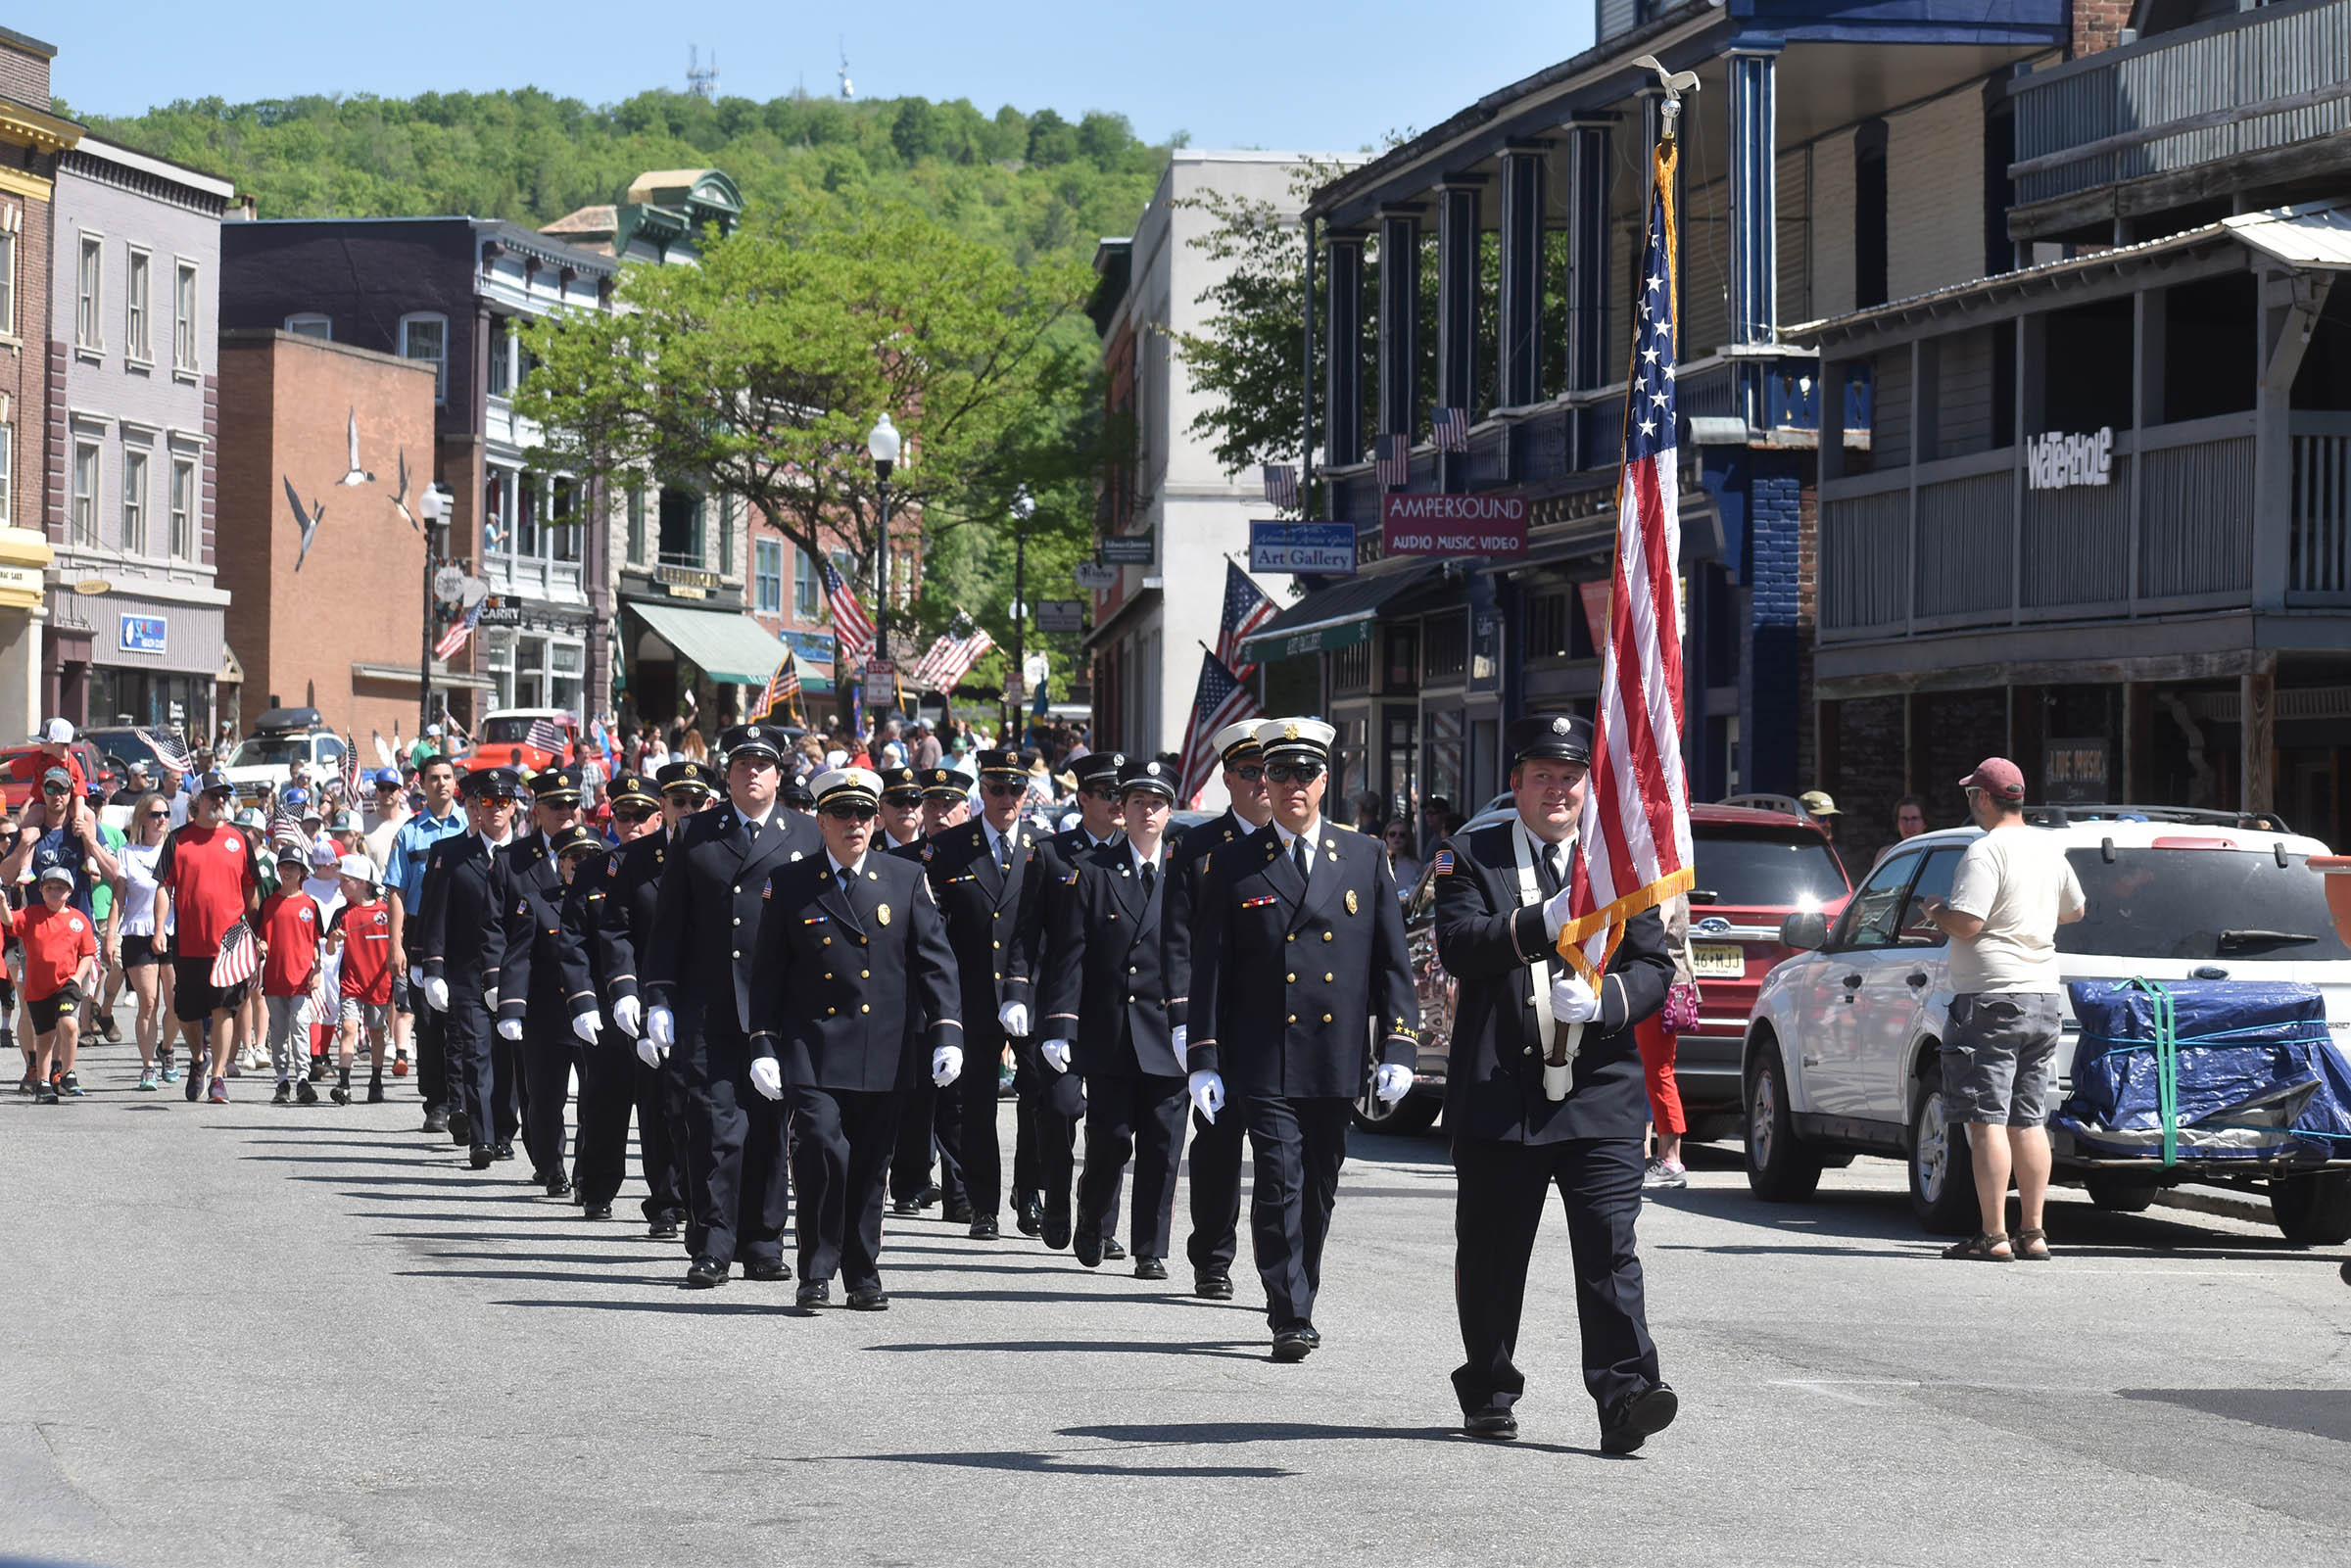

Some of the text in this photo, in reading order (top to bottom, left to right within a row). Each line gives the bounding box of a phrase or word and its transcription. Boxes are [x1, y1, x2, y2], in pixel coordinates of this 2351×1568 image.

[1390, 498, 1523, 519] AMPERSOUND
[1393, 535, 1519, 549] AUDIO MUSIC VIDEO
[1258, 549, 1349, 568] Art Gallery
[480, 607, 520, 620] CARRY
[869, 663, 892, 673] STOP
